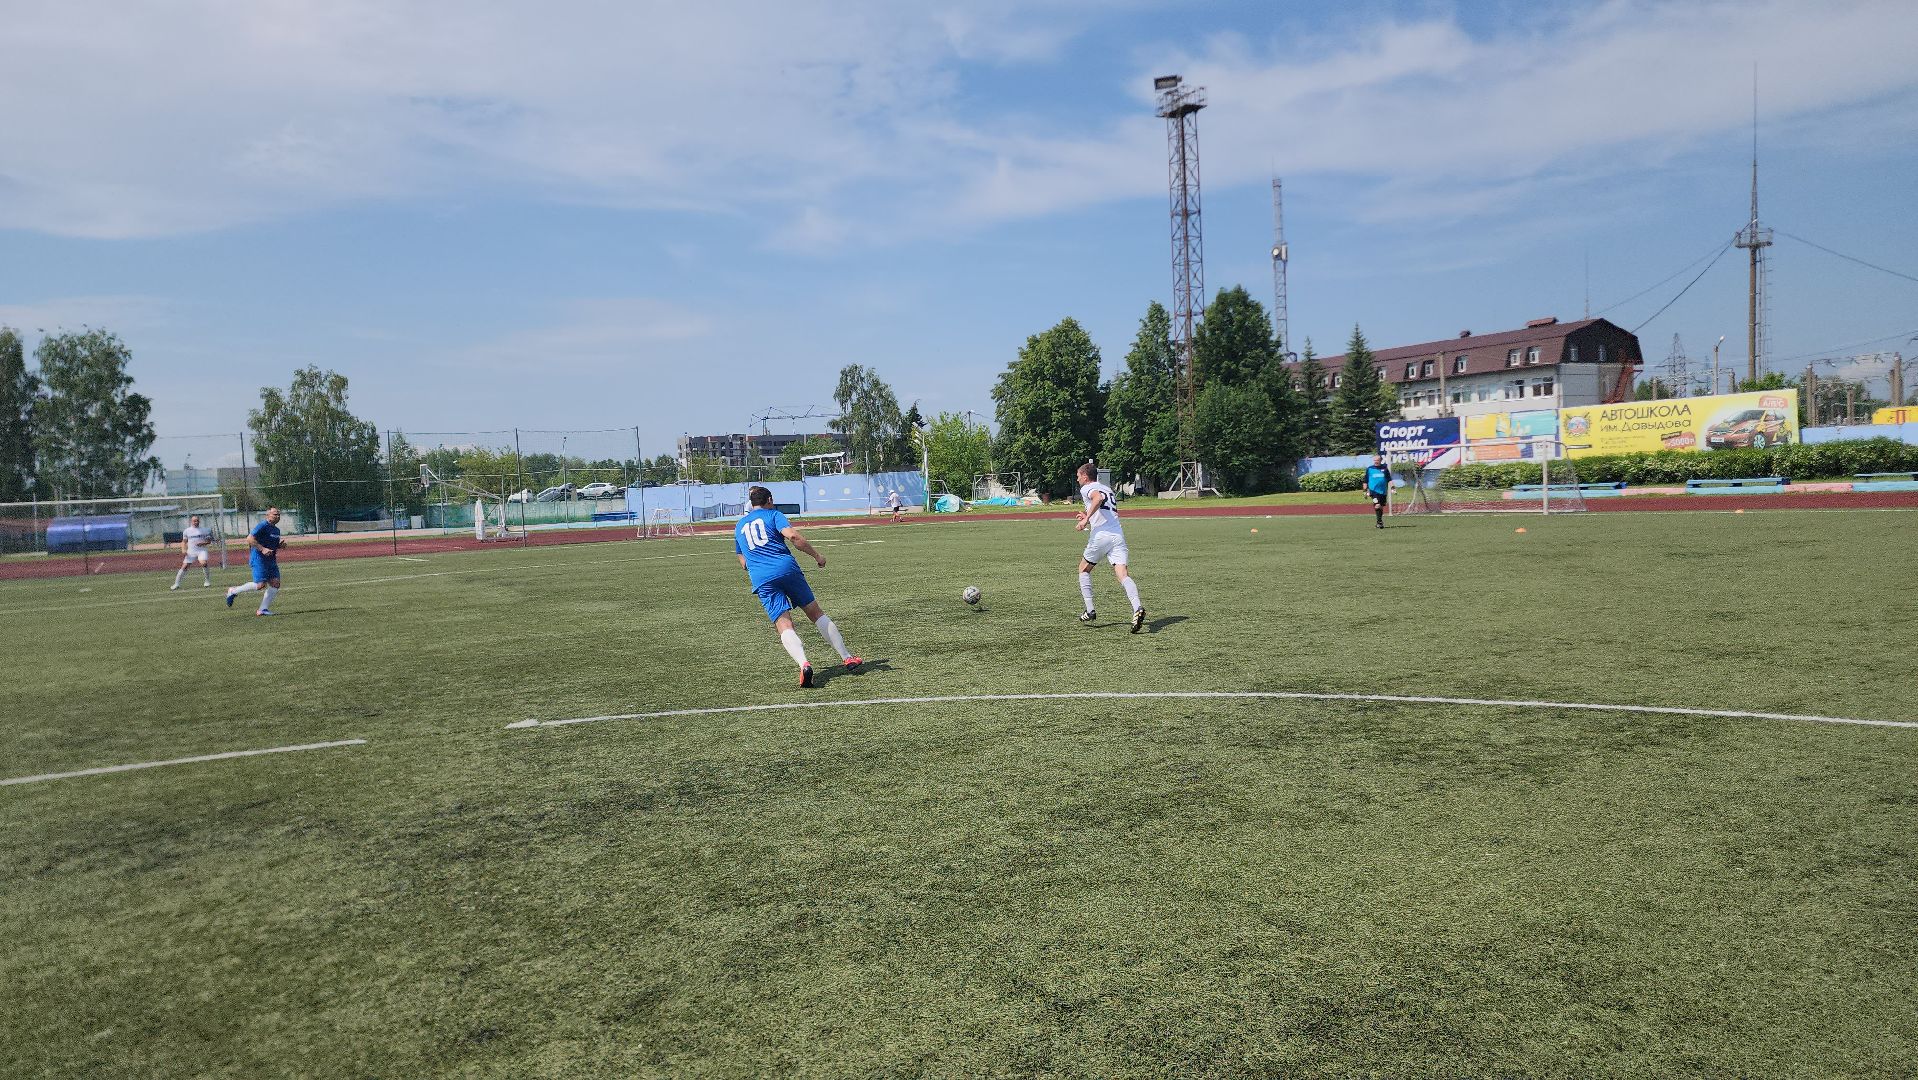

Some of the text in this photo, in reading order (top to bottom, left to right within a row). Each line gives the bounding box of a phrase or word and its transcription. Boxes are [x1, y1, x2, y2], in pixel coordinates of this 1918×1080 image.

[1601, 404, 1691, 421] АВТОШКОЛА
[1380, 425, 1426, 440] Спорт
[1622, 419, 1691, 432] Давыдова
[1380, 439, 1428, 451] норма
[741, 518, 769, 551] 10
